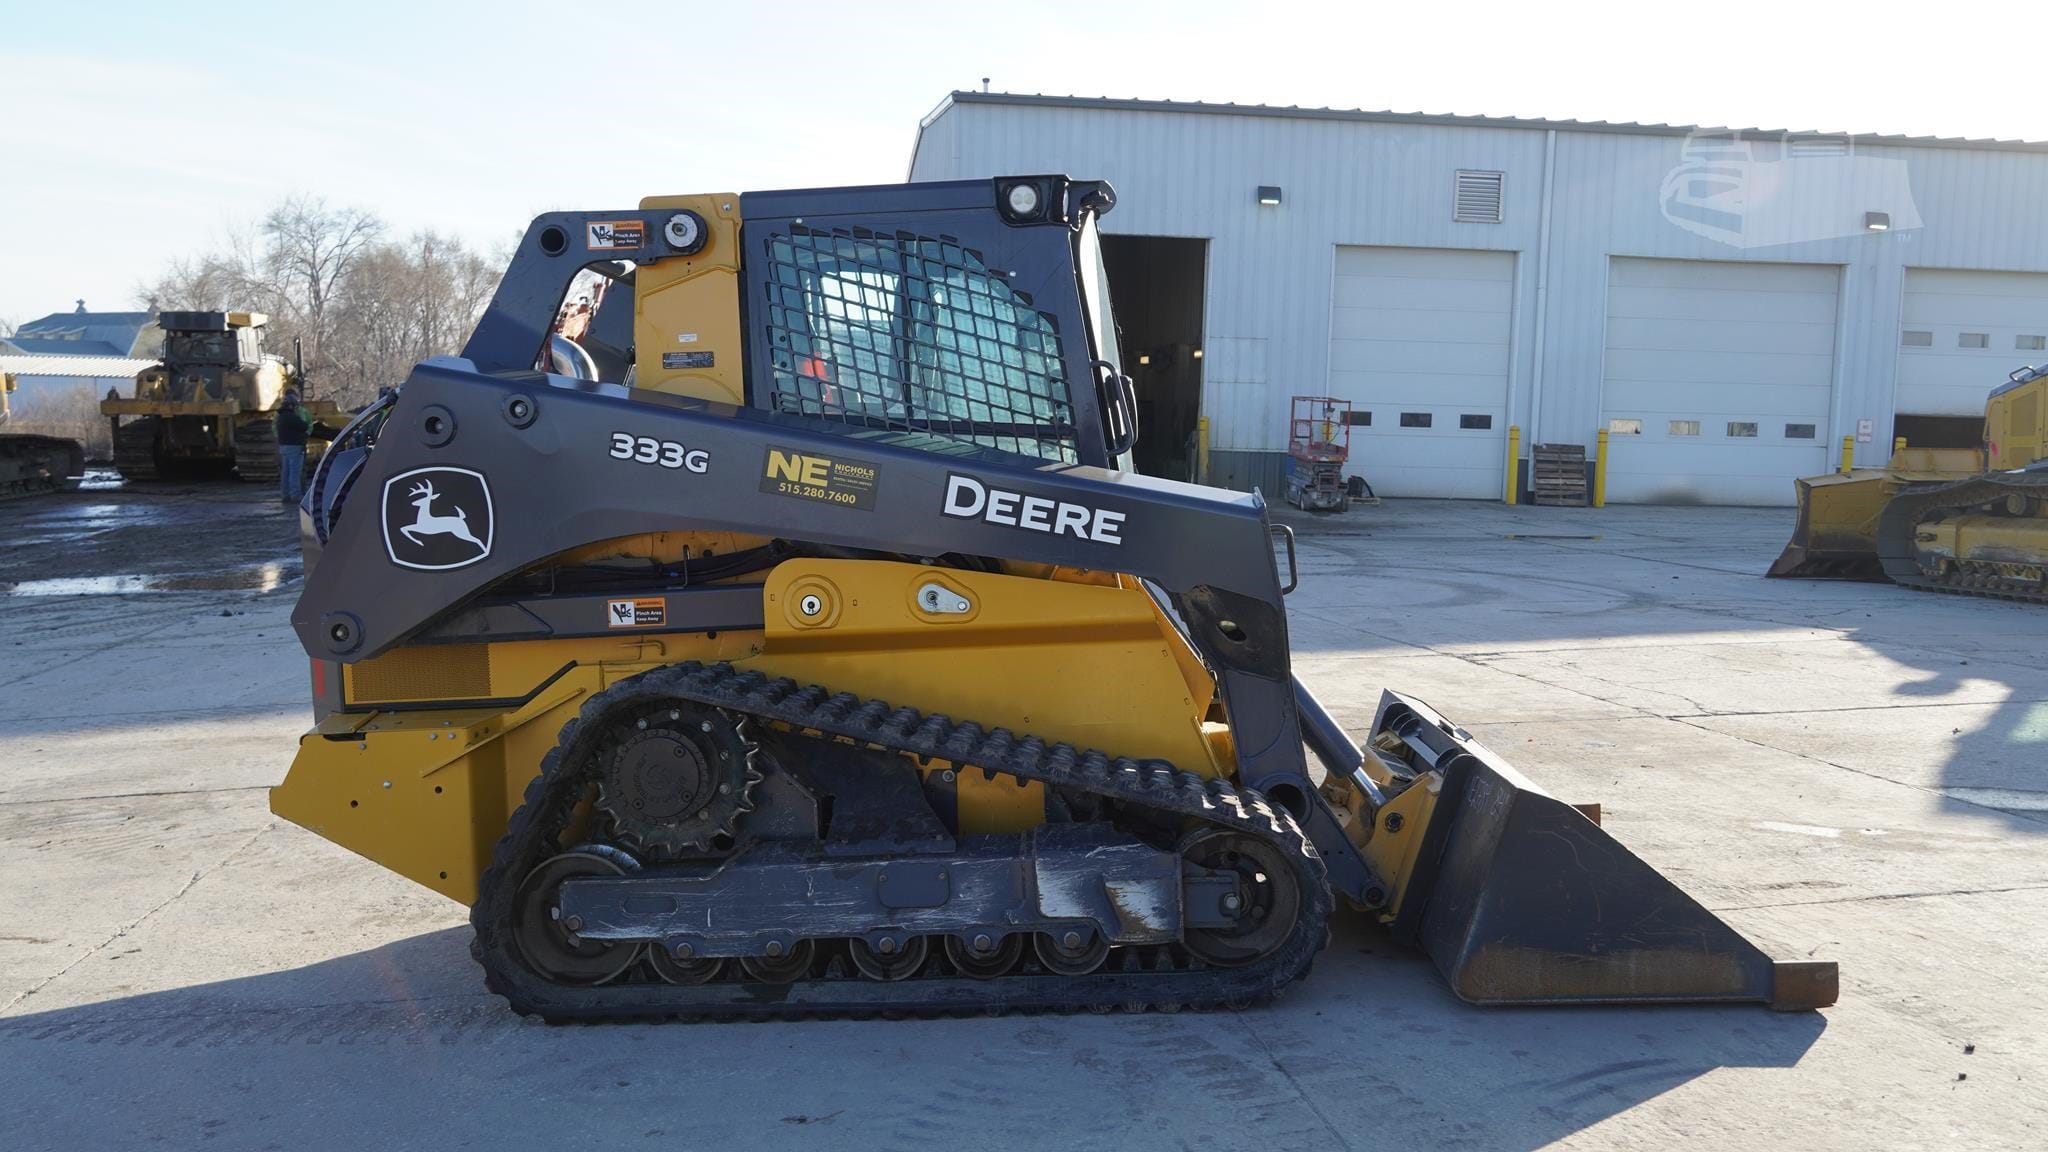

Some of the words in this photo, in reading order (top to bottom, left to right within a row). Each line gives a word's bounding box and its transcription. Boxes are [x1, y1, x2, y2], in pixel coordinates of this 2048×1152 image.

[610, 433, 709, 473] 333G
[767, 450, 832, 487] NE
[834, 463, 875, 476] NICHOLS
[779, 482, 856, 504] 515.280.7600
[944, 475, 1126, 545] DEERE
